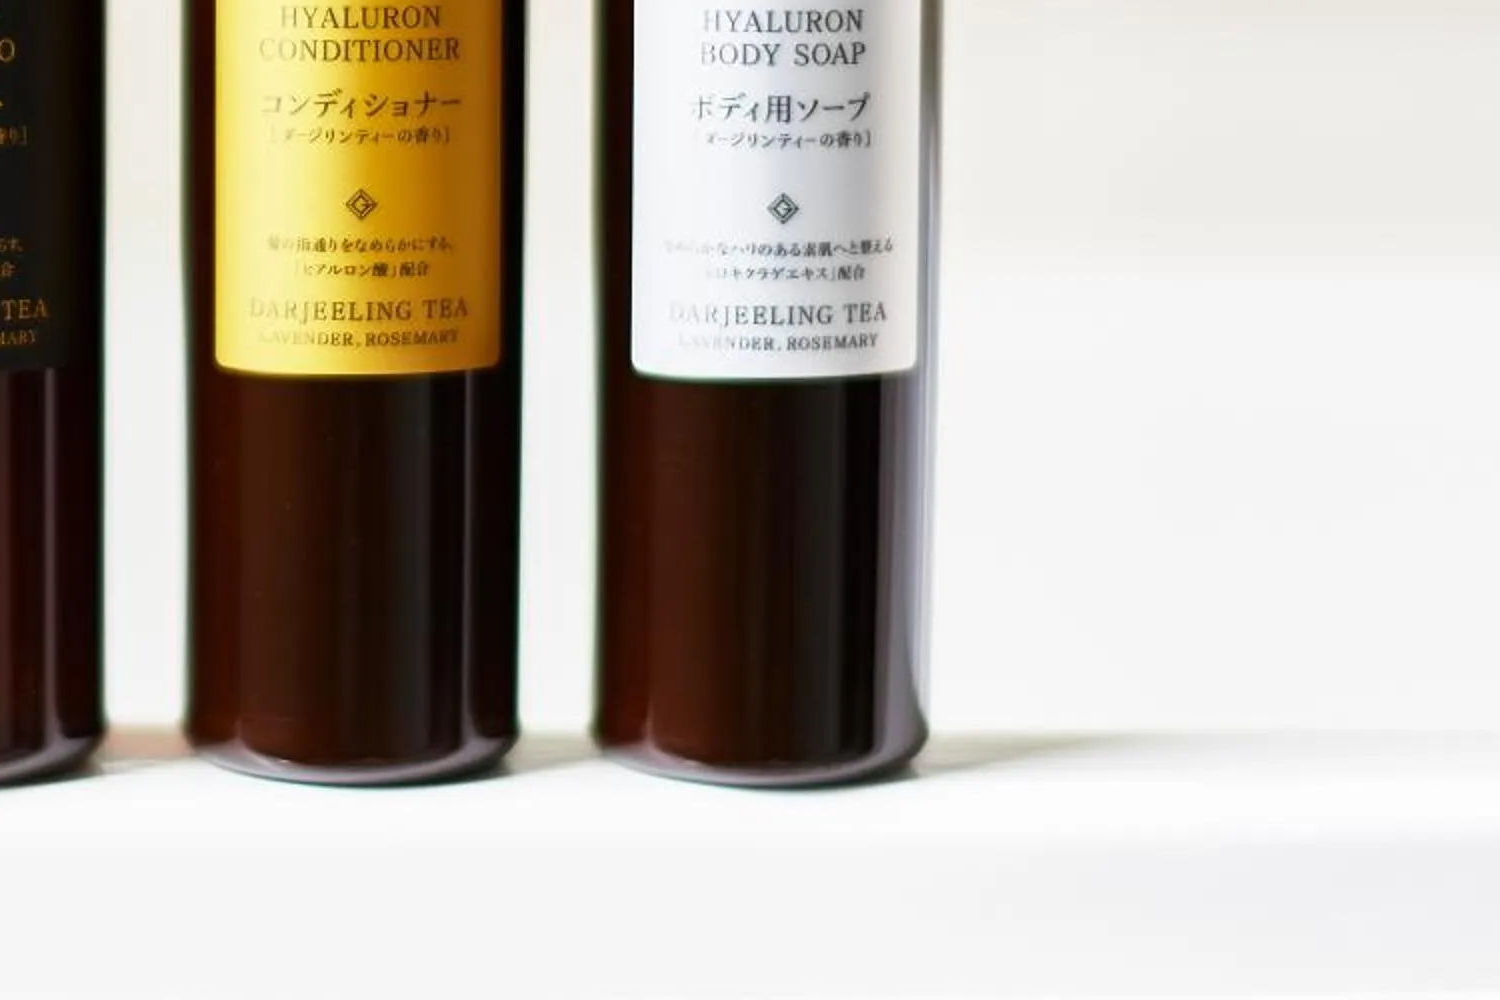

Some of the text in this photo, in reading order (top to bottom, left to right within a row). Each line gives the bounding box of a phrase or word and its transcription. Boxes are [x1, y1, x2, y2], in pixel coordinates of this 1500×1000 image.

[280, 5, 442, 30] HYALURON
[703, 9, 865, 34] HYALURON
[259, 37, 461, 63] CONDITIONER
[701, 41, 867, 67] BODY SOAP
[263, 88, 461, 120] コンディショナー
[692, 90, 872, 124] ボディ用ソープ
[2, 298, 49, 321] TEA
[250, 297, 469, 325] DARJEELING TEA
[668, 301, 888, 328] DARJEELING TEA
[365, 329, 458, 347] ROSEMARY
[787, 333, 878, 351] ROSEMARY
